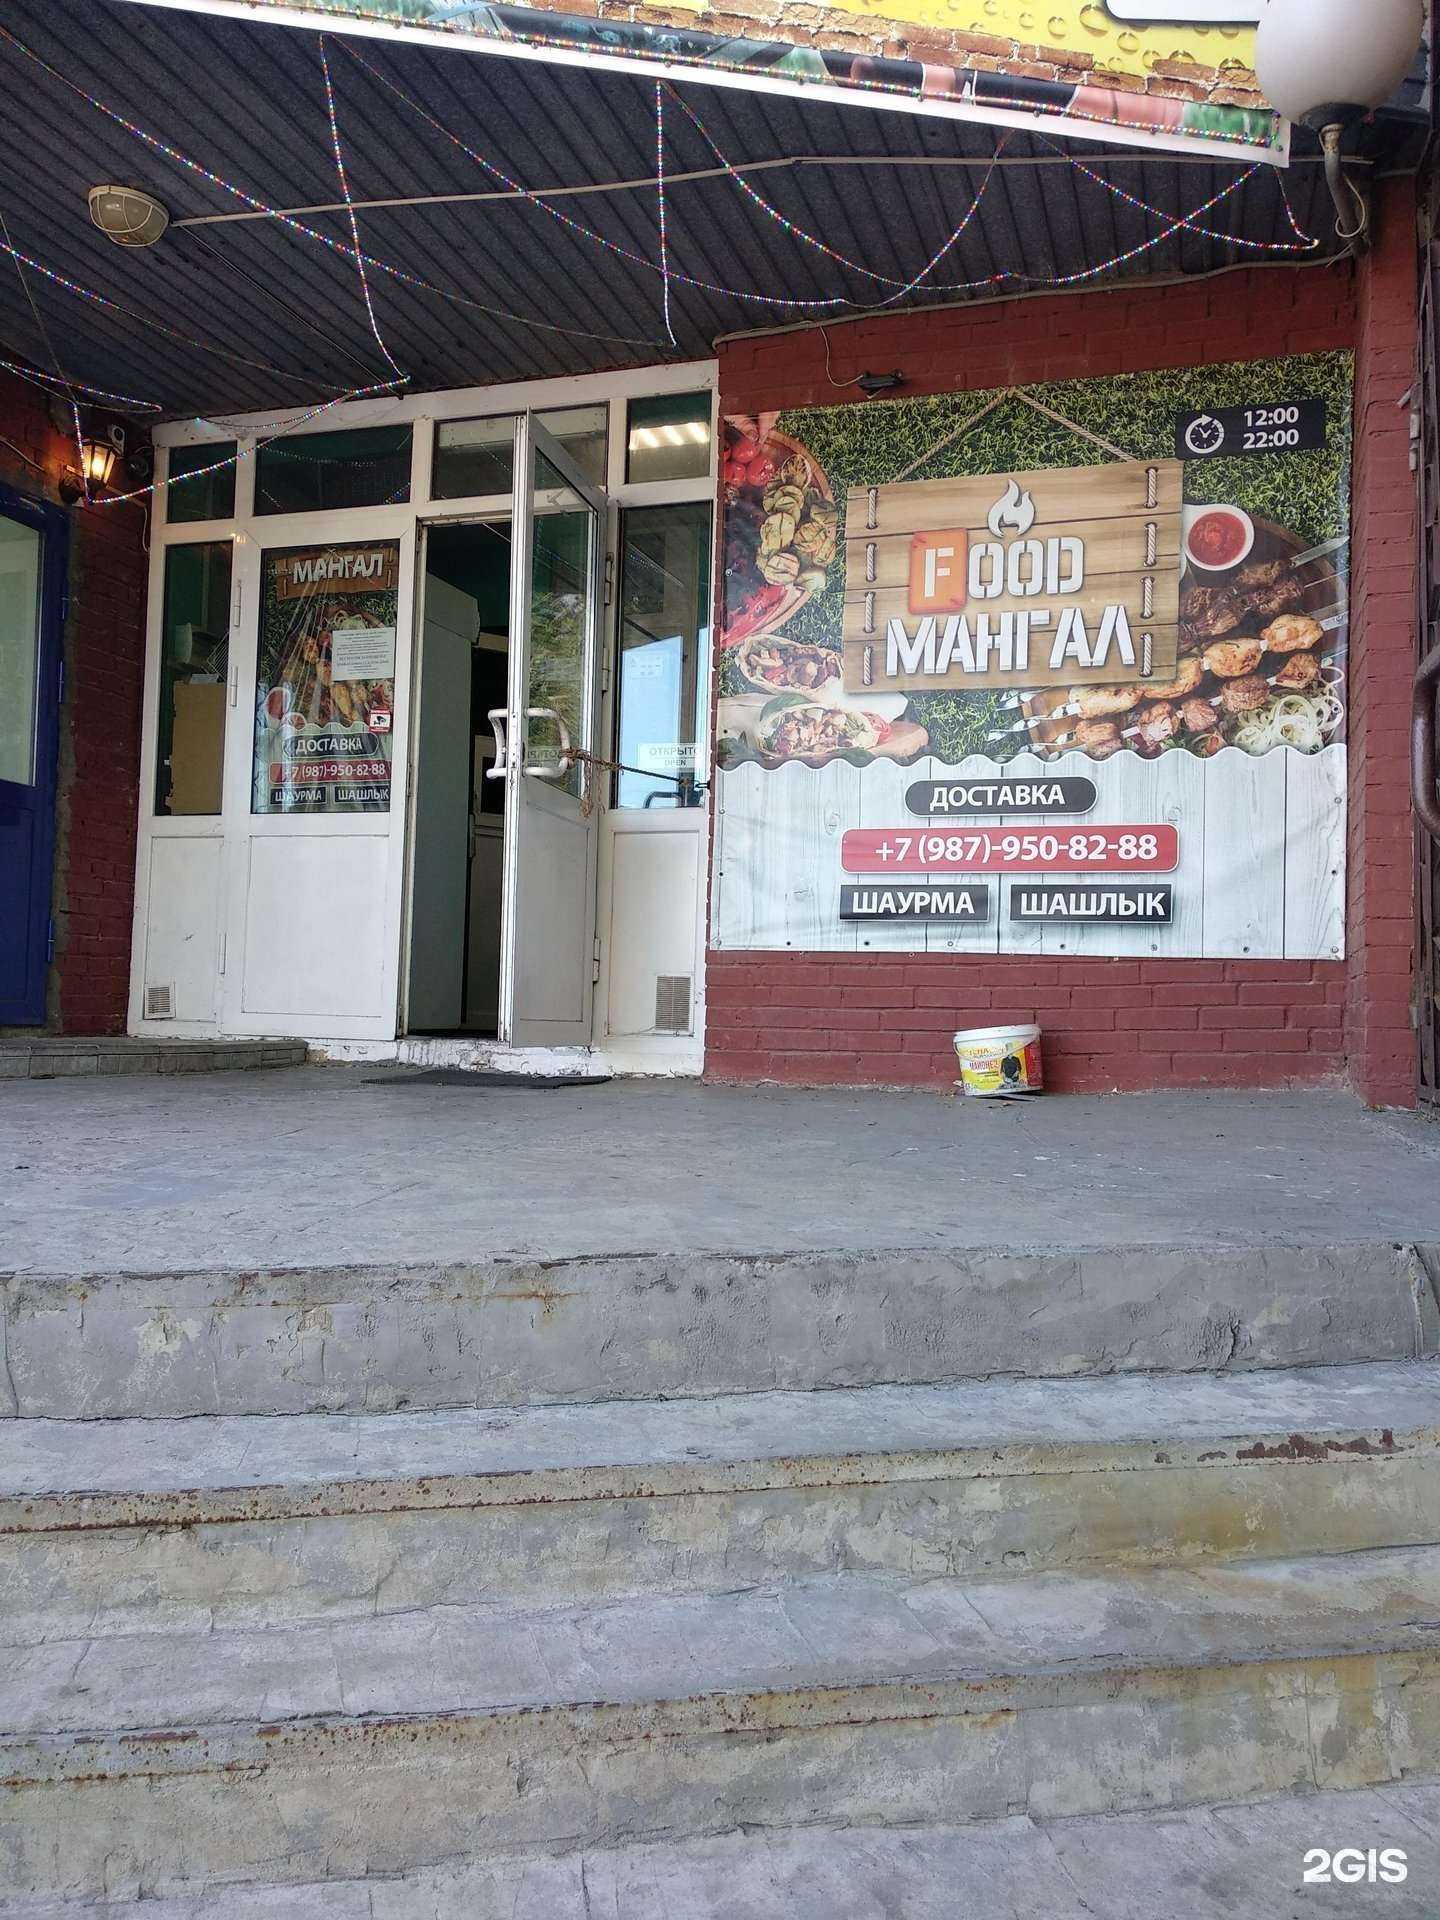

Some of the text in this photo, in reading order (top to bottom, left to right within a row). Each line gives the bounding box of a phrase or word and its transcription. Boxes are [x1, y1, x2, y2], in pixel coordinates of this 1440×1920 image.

[1244, 406, 1299, 427] 12:00
[1243, 429, 1299, 449] 22:00
[293, 553, 384, 585] МАНГАЛ
[923, 536, 1084, 599] FOOD
[886, 604, 1136, 677] МАНГАЛ
[296, 737, 363, 754] ДОСТАВКА
[274, 789, 322, 801] ШАУРМА
[338, 787, 390, 801] ШАШЛЫК
[929, 784, 1066, 812] ДОСТАВКА
[875, 833, 1159, 864] +7 (987)-950-82-88
[852, 891, 976, 915] ШАУРМА
[1020, 892, 1166, 917] ШАШЛЫК
